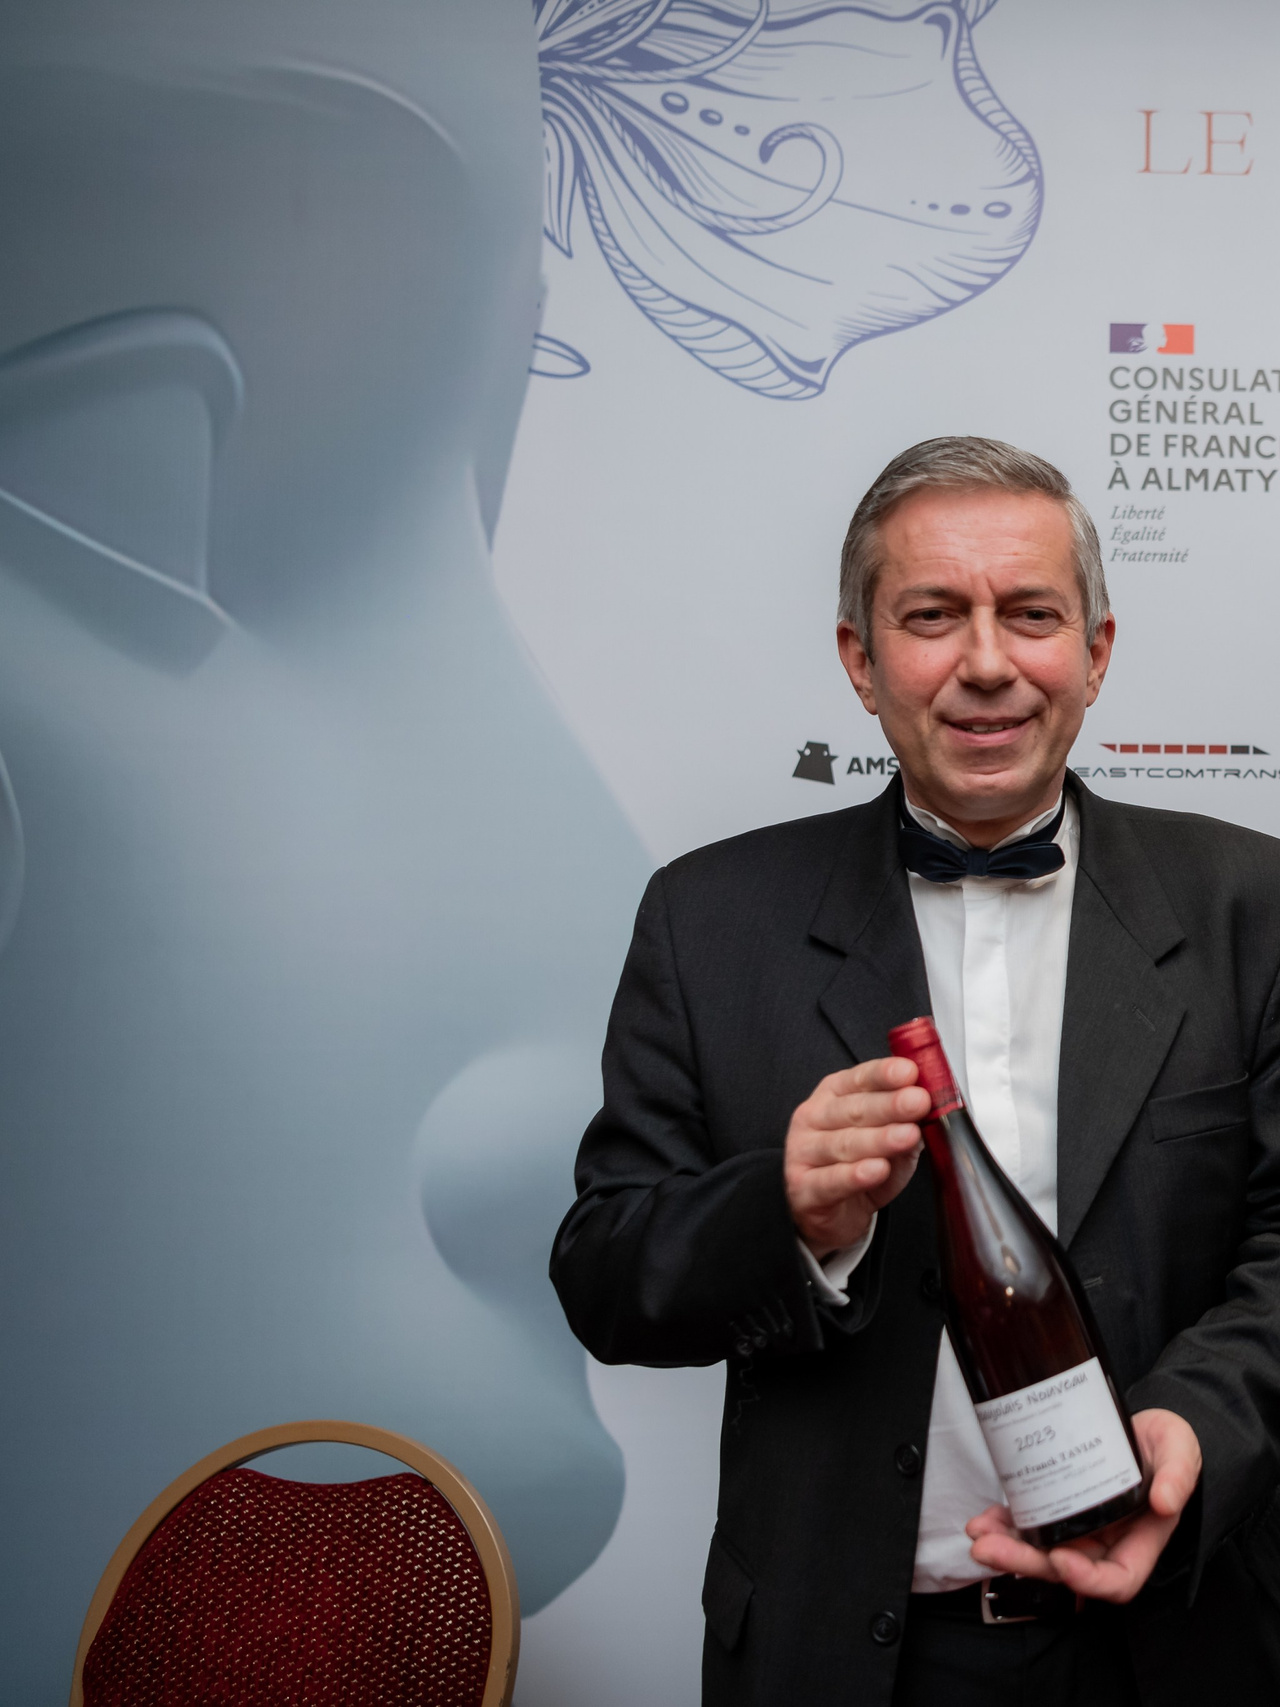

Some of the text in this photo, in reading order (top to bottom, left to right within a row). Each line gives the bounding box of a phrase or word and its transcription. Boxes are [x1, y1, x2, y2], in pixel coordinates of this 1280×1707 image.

[1137, 109, 1255, 176] LE
[1109, 394, 1264, 425] GÉNÉRAL
[1110, 433, 1151, 457] DE
[1107, 460, 1278, 493] À ALMATY
[1109, 505, 1166, 521] Liberté
[1109, 525, 1166, 545] Égalité
[1109, 548, 1190, 563] Fraternité
[846, 756, 900, 776] AMS
[1014, 1425, 1056, 1452] 2023
